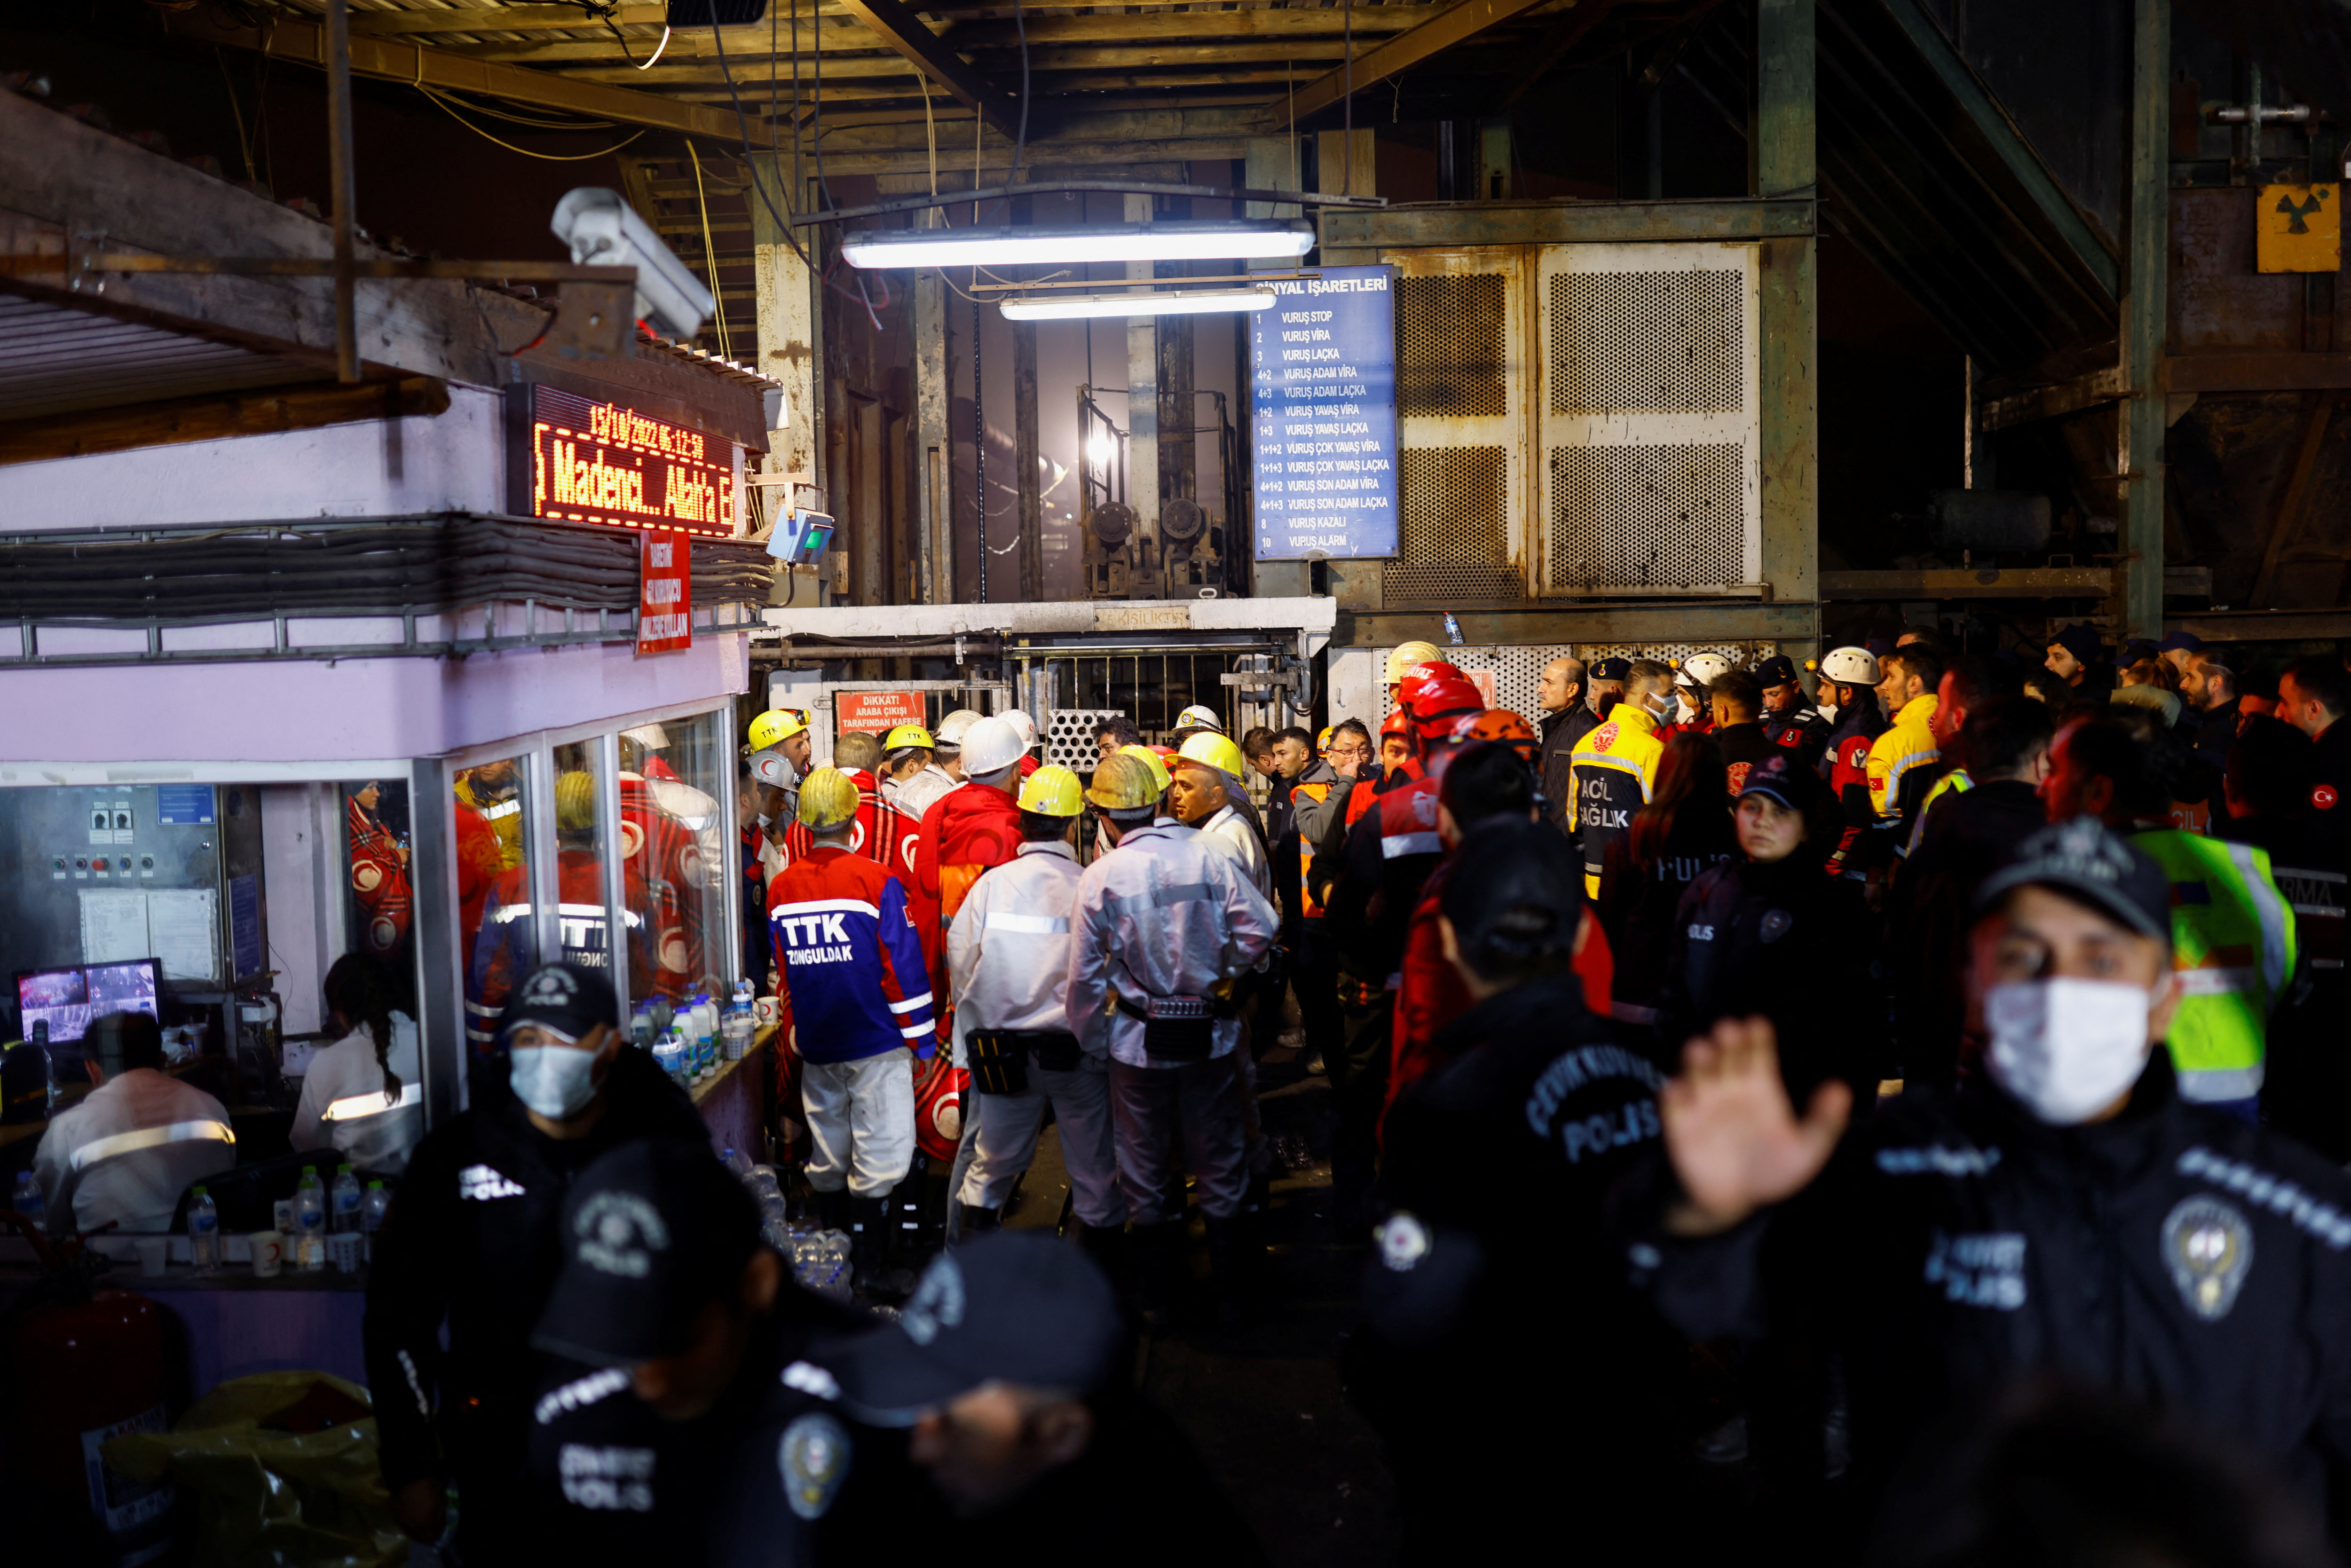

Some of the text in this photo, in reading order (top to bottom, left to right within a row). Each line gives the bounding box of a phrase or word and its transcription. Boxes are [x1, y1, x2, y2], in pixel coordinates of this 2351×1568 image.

[1308, 275, 1388, 297] İŞARETLERİ
[1256, 311, 1333, 324] 1 VURUŞ STOP
[1257, 328, 1330, 343] 2 VURUŞ VİRA
[1257, 348, 1340, 362] 3 VURUŞ LAÇKA
[1257, 364, 1357, 381] 4+2 VURUŞ ADAM VİRA
[1258, 385, 1366, 400] 4+3 VURUŞ ADAM LAÇKA
[1259, 402, 1359, 418] 1+2 VURUŞ YAVAŞ VİRA
[1260, 422, 1369, 437] 1+3 VURUŞ YAVAŞ LAÇKA
[1260, 438, 1381, 456] 1+1+2 VURUŞ ÇOK YAVAŞ VİRA
[1260, 459, 1389, 474] 1+1+3 VURUŞ ÇOK YAVAŞ LAÇKA
[1261, 476, 1379, 493] 4+1+2 VURUŞ SON ADAM VİRA
[1261, 496, 1388, 512] 4+1+3 VURUŞ SON ADAM LAÇKA
[1261, 517, 1346, 530] 8 VURUŞ KAZALI
[1262, 535, 1347, 549] 10 VURUŞ ALARM
[856, 707, 907, 717] ARABA ÇIKIŞI
[843, 717, 922, 728] TARAFINDAN KAFESE
[761, 727, 778, 738] TTK
[1581, 777, 1613, 801] ACİL
[781, 913, 850, 946] TTK
[787, 945, 853, 965] ZONGULDAK
